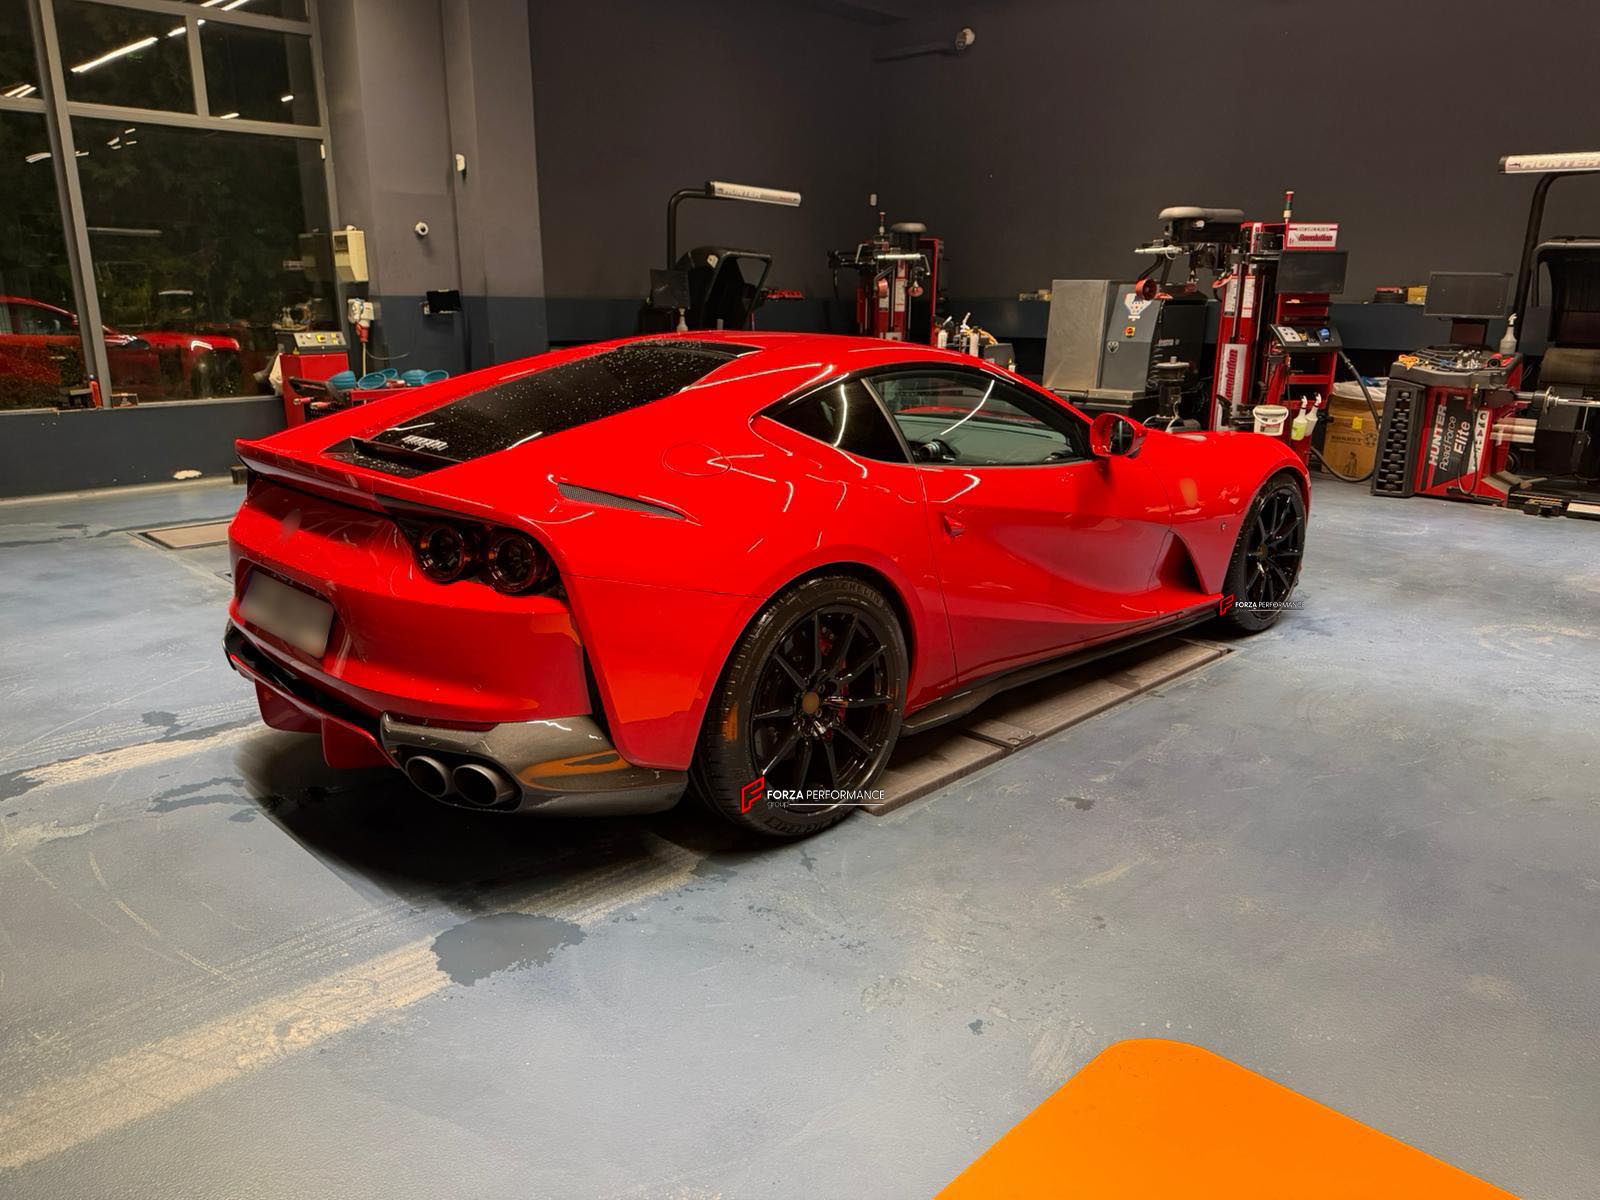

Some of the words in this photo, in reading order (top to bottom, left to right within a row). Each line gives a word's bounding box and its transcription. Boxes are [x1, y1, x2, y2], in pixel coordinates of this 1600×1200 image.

[1225, 348, 1238, 400] evolution
[1429, 404, 1447, 466] HUNTER
[1442, 416, 1457, 444] Force
[1453, 421, 1470, 454] Elite
[1438, 444, 1453, 471] Road
